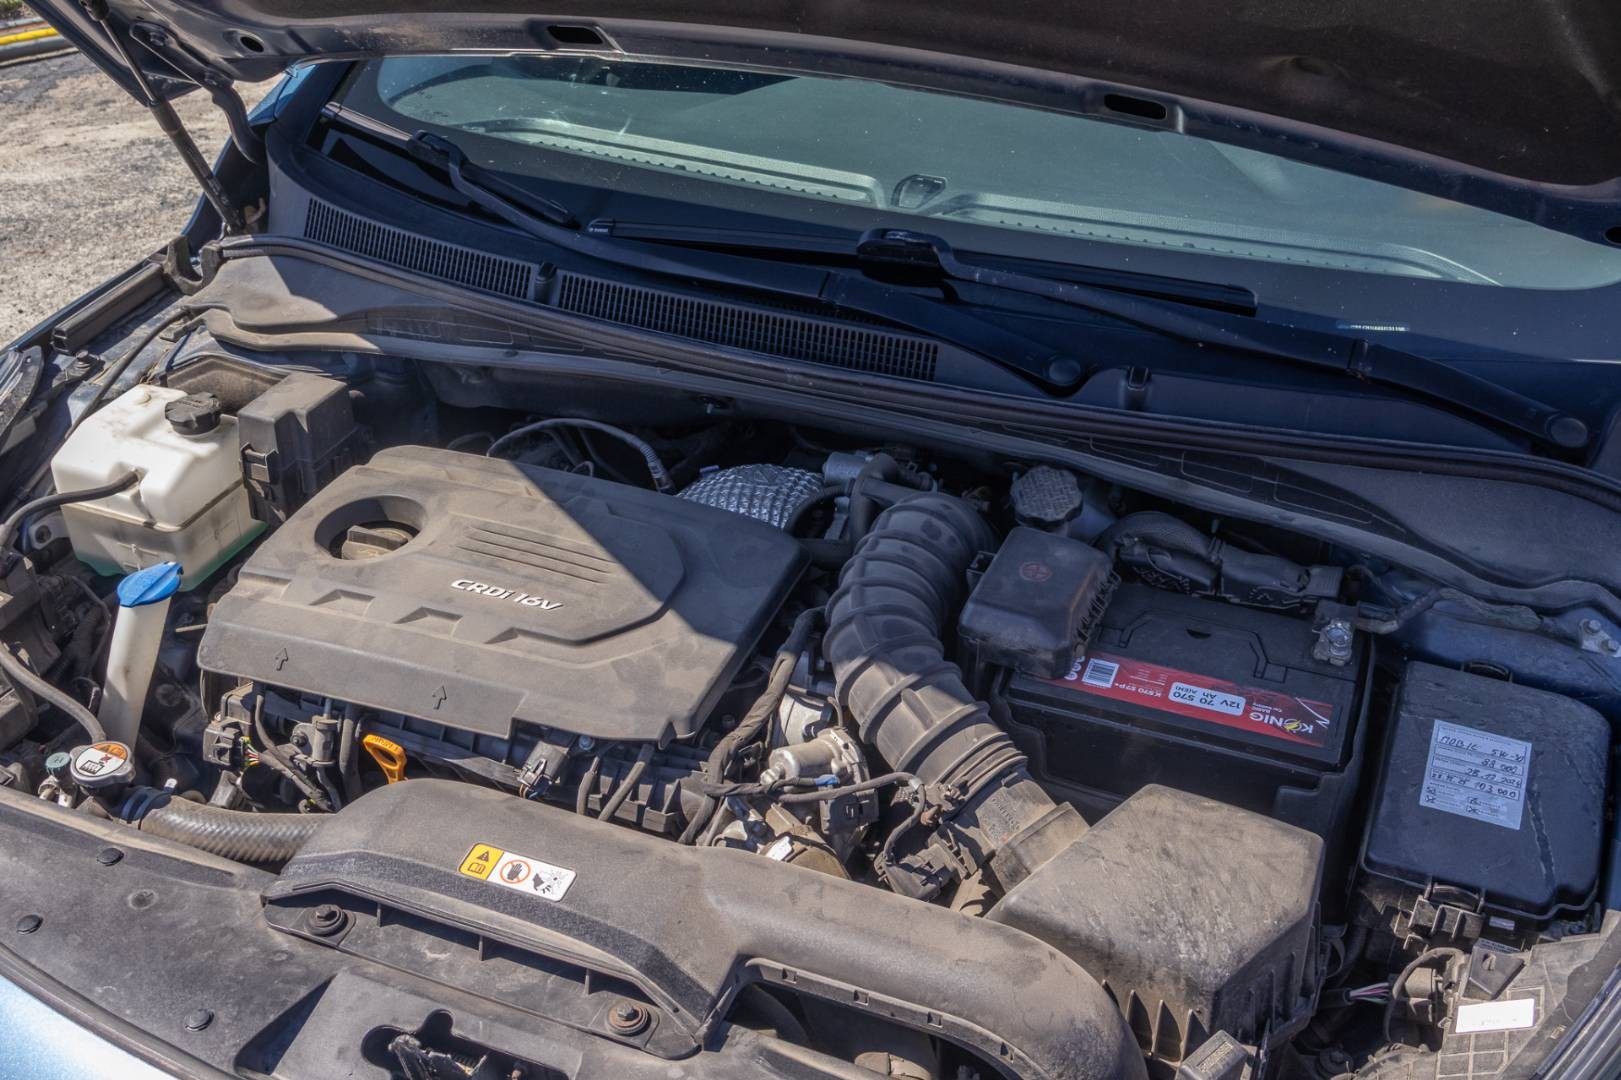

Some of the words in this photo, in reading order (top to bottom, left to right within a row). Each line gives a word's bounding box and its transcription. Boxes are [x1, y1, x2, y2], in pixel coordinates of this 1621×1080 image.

[513, 593, 564, 610] 16V
[1173, 691, 1196, 702] 570
[1200, 697, 1215, 706] 70
[1220, 699, 1241, 709] 12V
